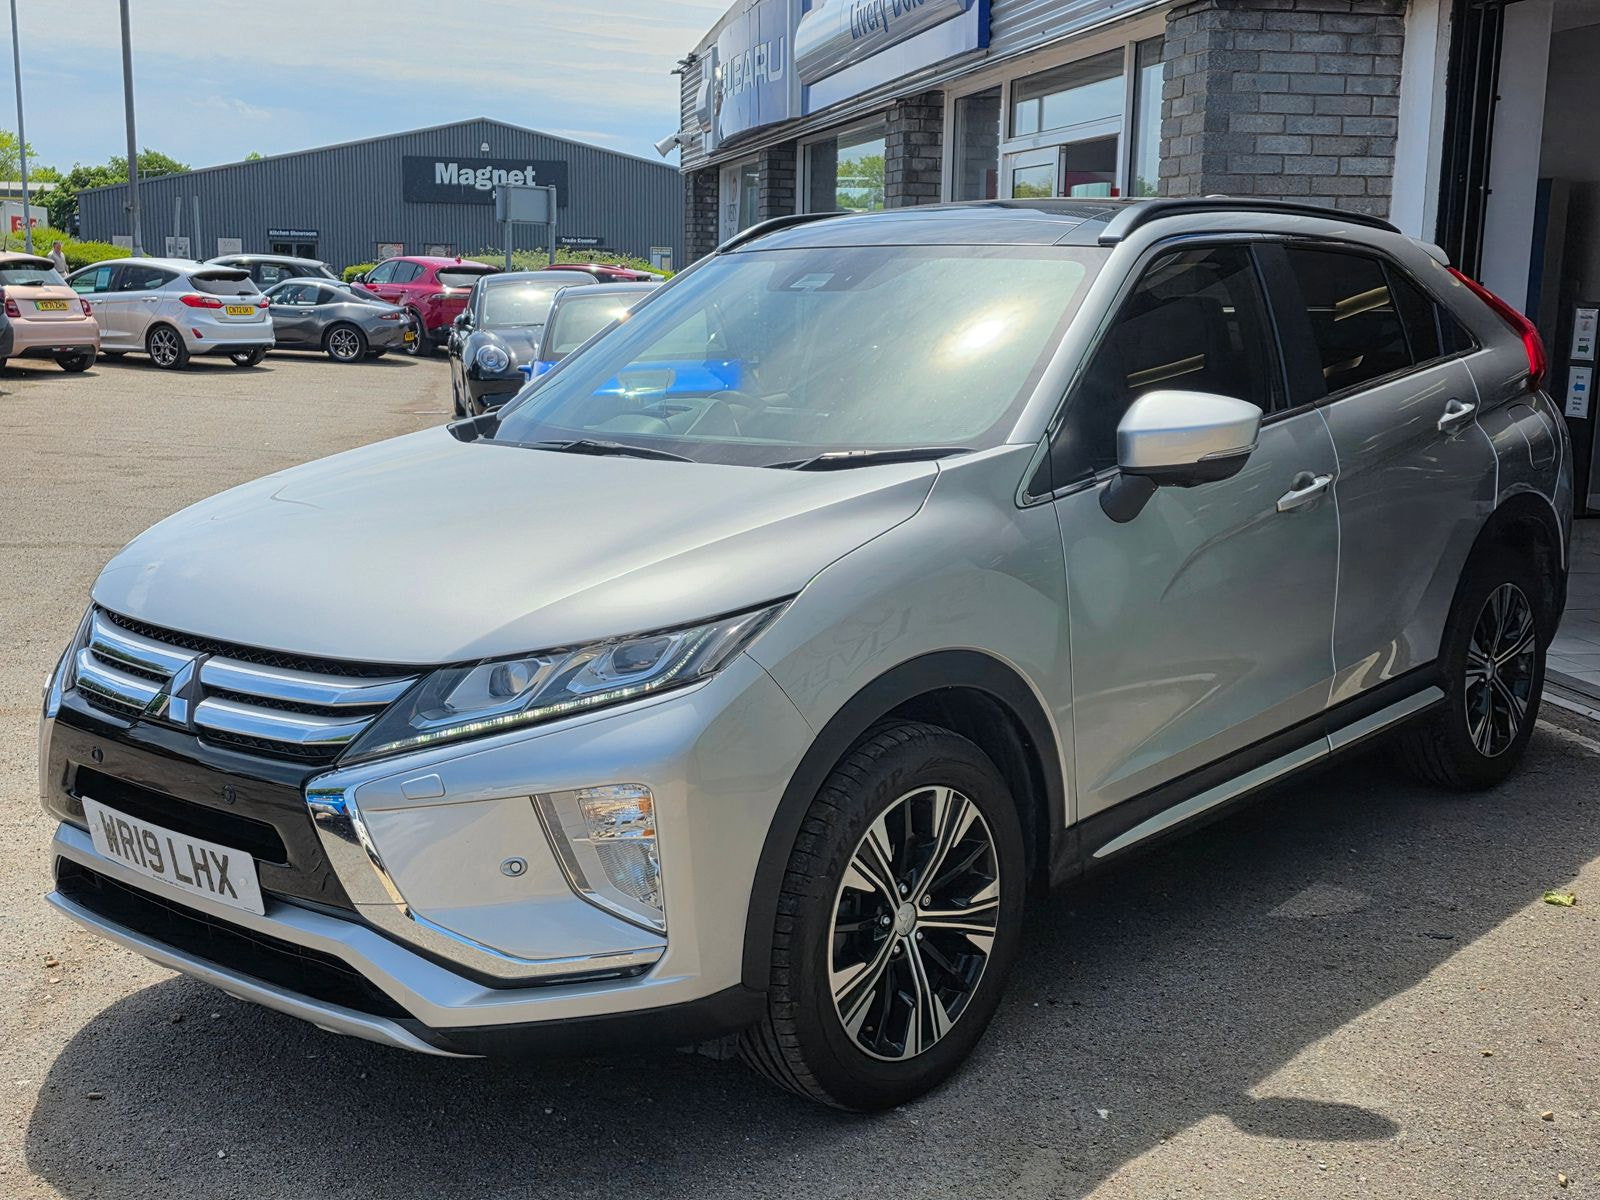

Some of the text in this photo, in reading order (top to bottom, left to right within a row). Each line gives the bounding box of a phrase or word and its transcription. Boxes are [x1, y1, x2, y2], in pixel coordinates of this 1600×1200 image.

[850, 0, 889, 40] Livery
[721, 36, 784, 98] SUBARU
[435, 162, 536, 190] Magnet
[98, 810, 238, 900] WR19 LHX
